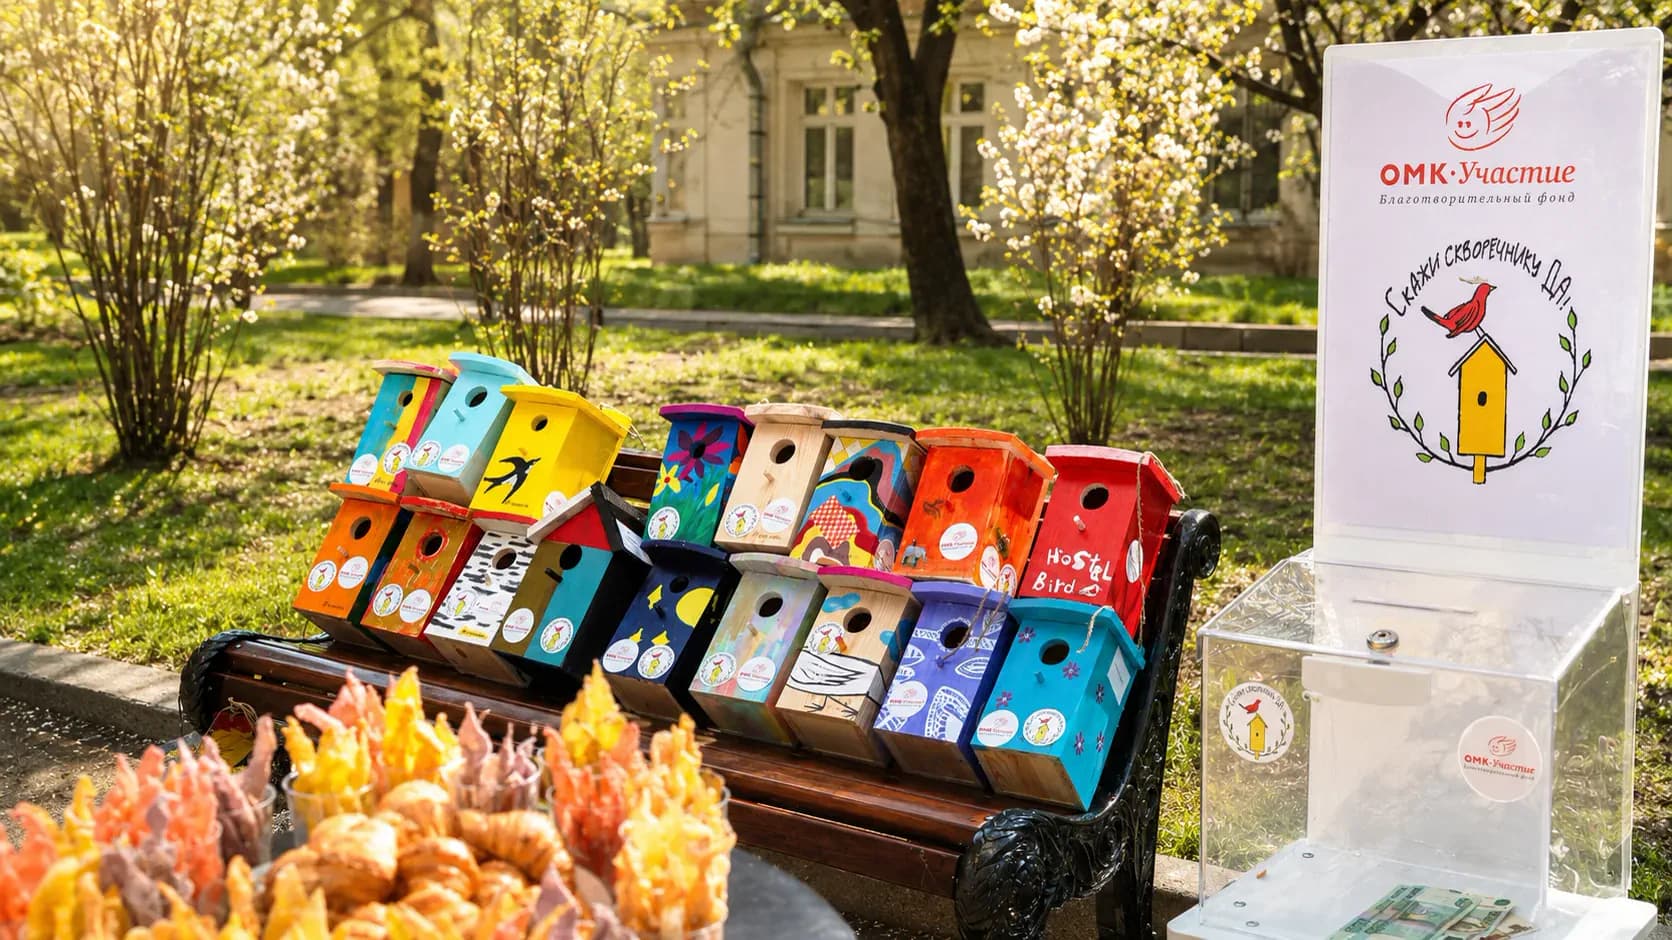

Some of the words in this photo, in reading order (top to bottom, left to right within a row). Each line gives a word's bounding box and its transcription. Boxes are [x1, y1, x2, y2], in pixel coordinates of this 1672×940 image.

[1379, 192, 1532, 206] Благотворительный
[1537, 192, 1576, 206] фонд
[1444, 237, 1542, 278] СКВОРЕЧНИКУ
[1541, 259, 1572, 310] ДА!
[1032, 571, 1076, 593] Bird
